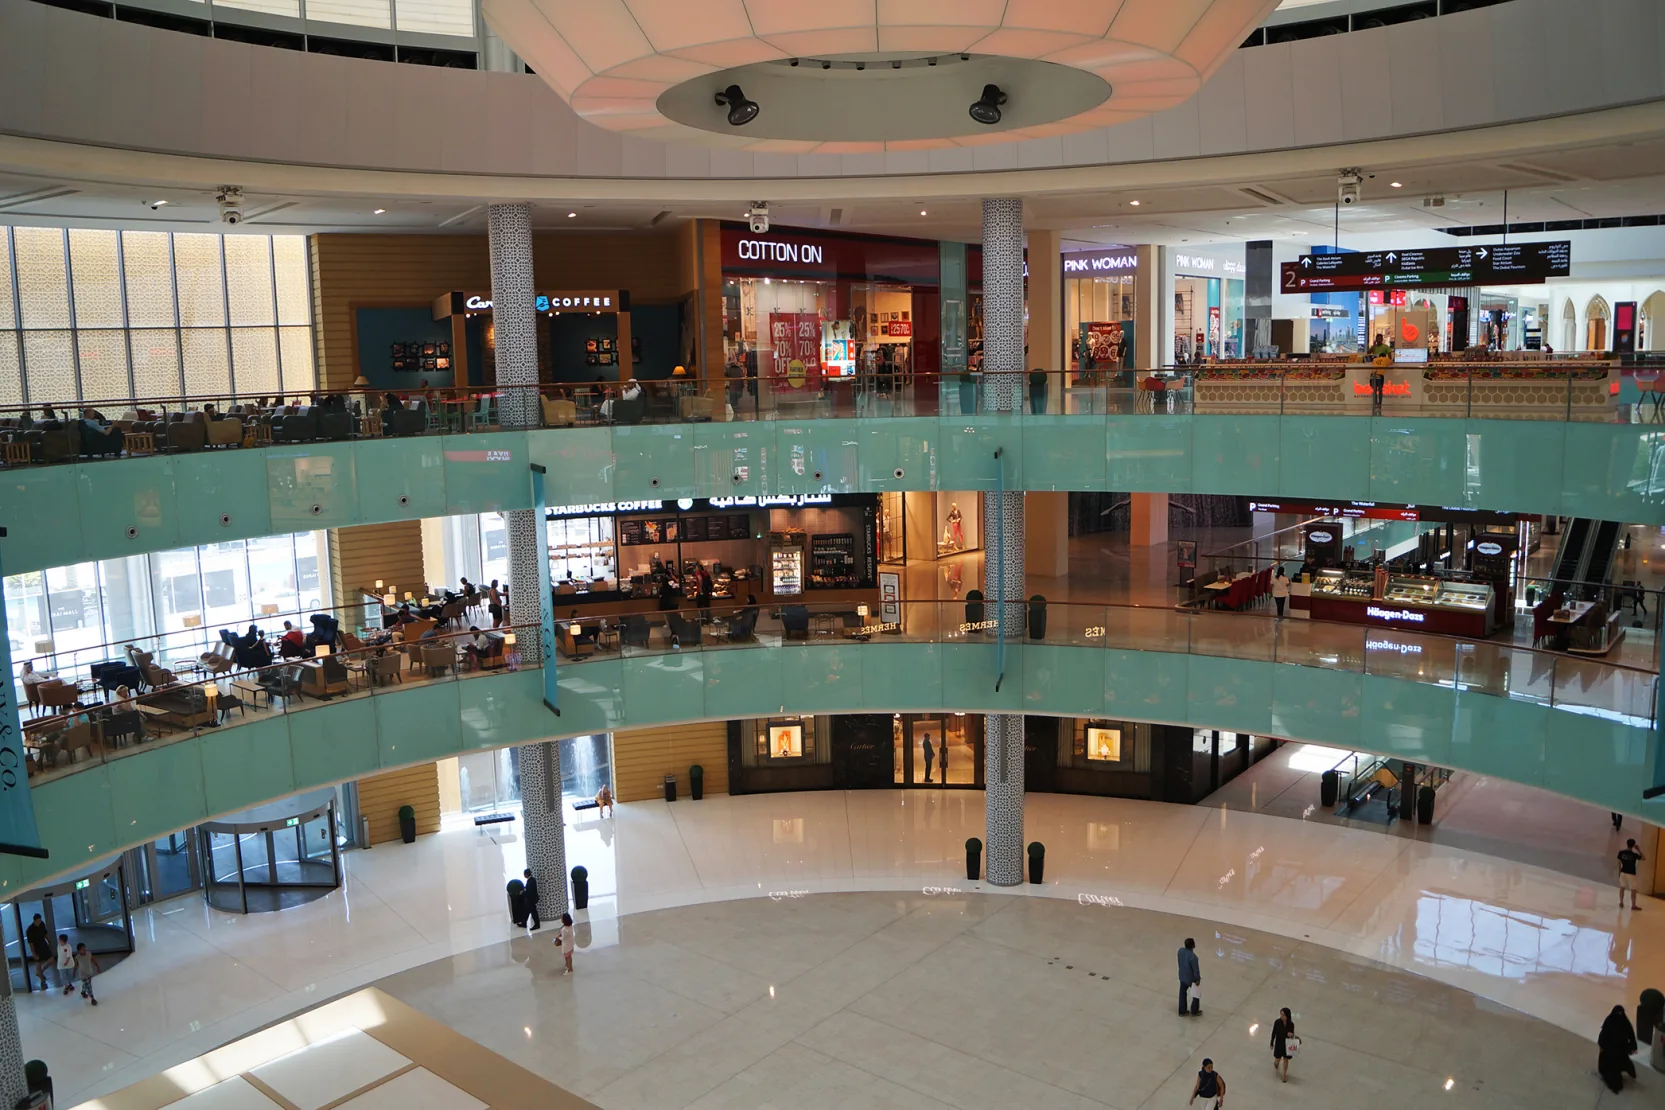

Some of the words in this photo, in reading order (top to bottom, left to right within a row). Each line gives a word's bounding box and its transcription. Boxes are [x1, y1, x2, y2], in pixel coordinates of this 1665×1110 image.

[738, 240, 798, 262] COTTON
[801, 244, 822, 264] ON
[1064, 259, 1088, 272] PINK
[1092, 256, 1137, 270] WOMAN
[1176, 255, 1190, 267] PINK
[1191, 257, 1214, 270] WOMAN
[1285, 271, 1296, 287] 2
[552, 297, 611, 307] COFFEE
[774, 321, 791, 337] 25%
[799, 321, 816, 337] 25%
[775, 340, 791, 357] 70%
[799, 340, 816, 356] 70%
[544, 502, 616, 516] STARBUCKS
[617, 500, 662, 511] COFFEE
[1367, 606, 1424, 621] Häagen-Dazs
